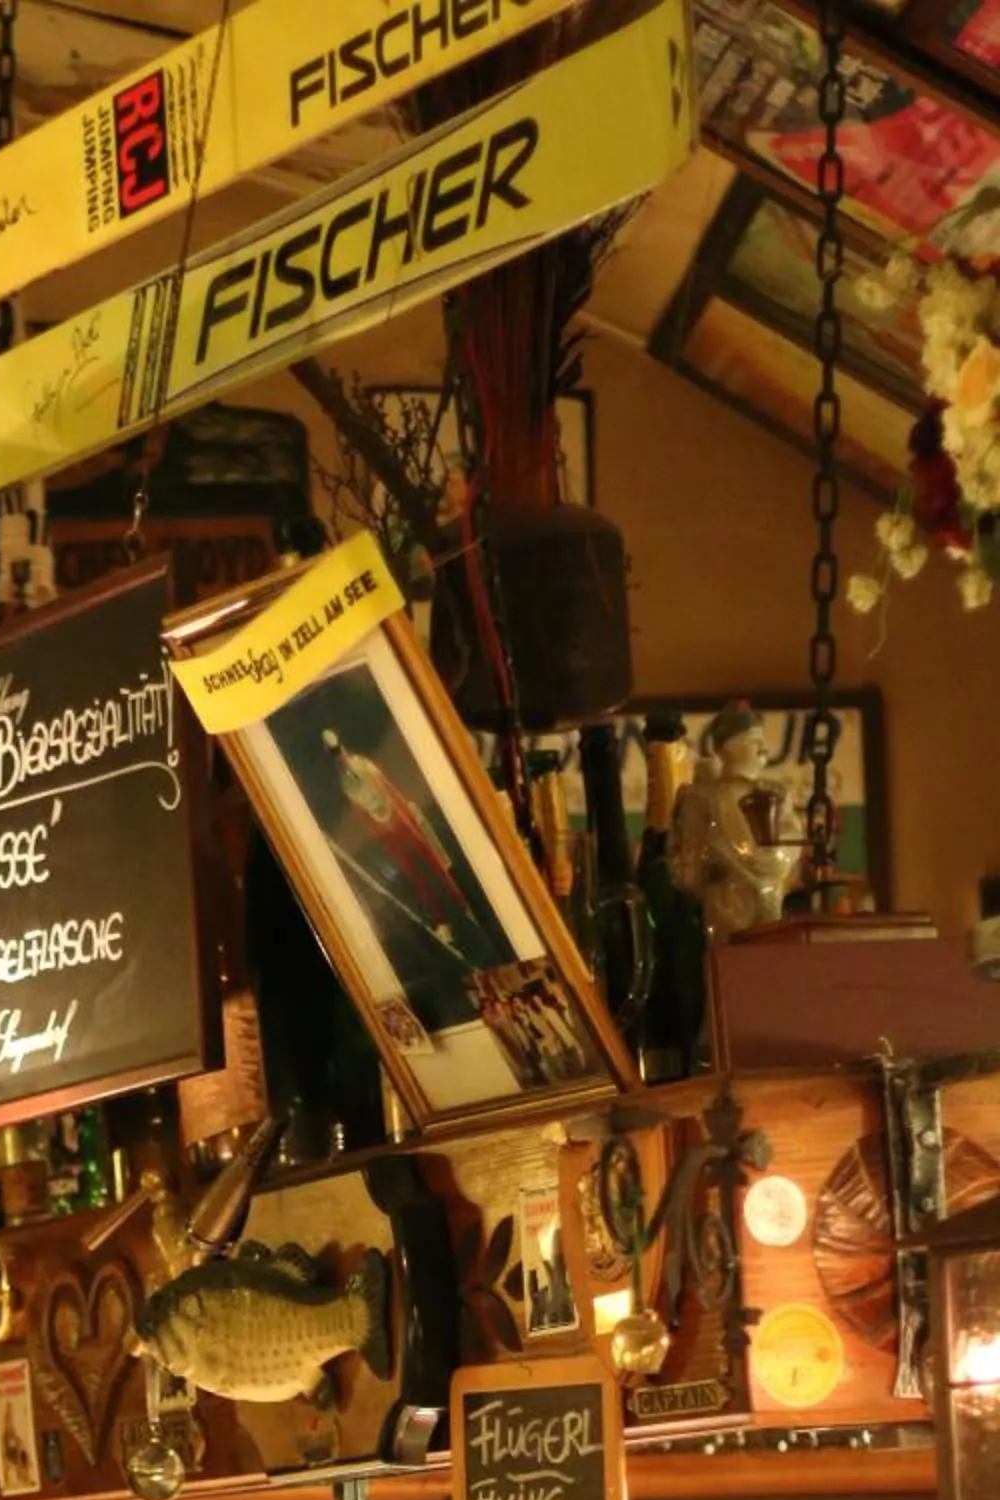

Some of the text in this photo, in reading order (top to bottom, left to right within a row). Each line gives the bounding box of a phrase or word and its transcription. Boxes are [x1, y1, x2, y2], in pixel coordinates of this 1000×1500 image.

[289, 0, 533, 128] FISCHE
[83, 114, 100, 234] JUMPING
[98, 106, 115, 224] JUMPING
[117, 76, 168, 210] RCJ
[195, 117, 539, 365] FISCHER
[278, 637, 295, 663] IN
[292, 615, 325, 651] ZELL
[324, 594, 345, 625] AM
[344, 570, 378, 607] SEE
